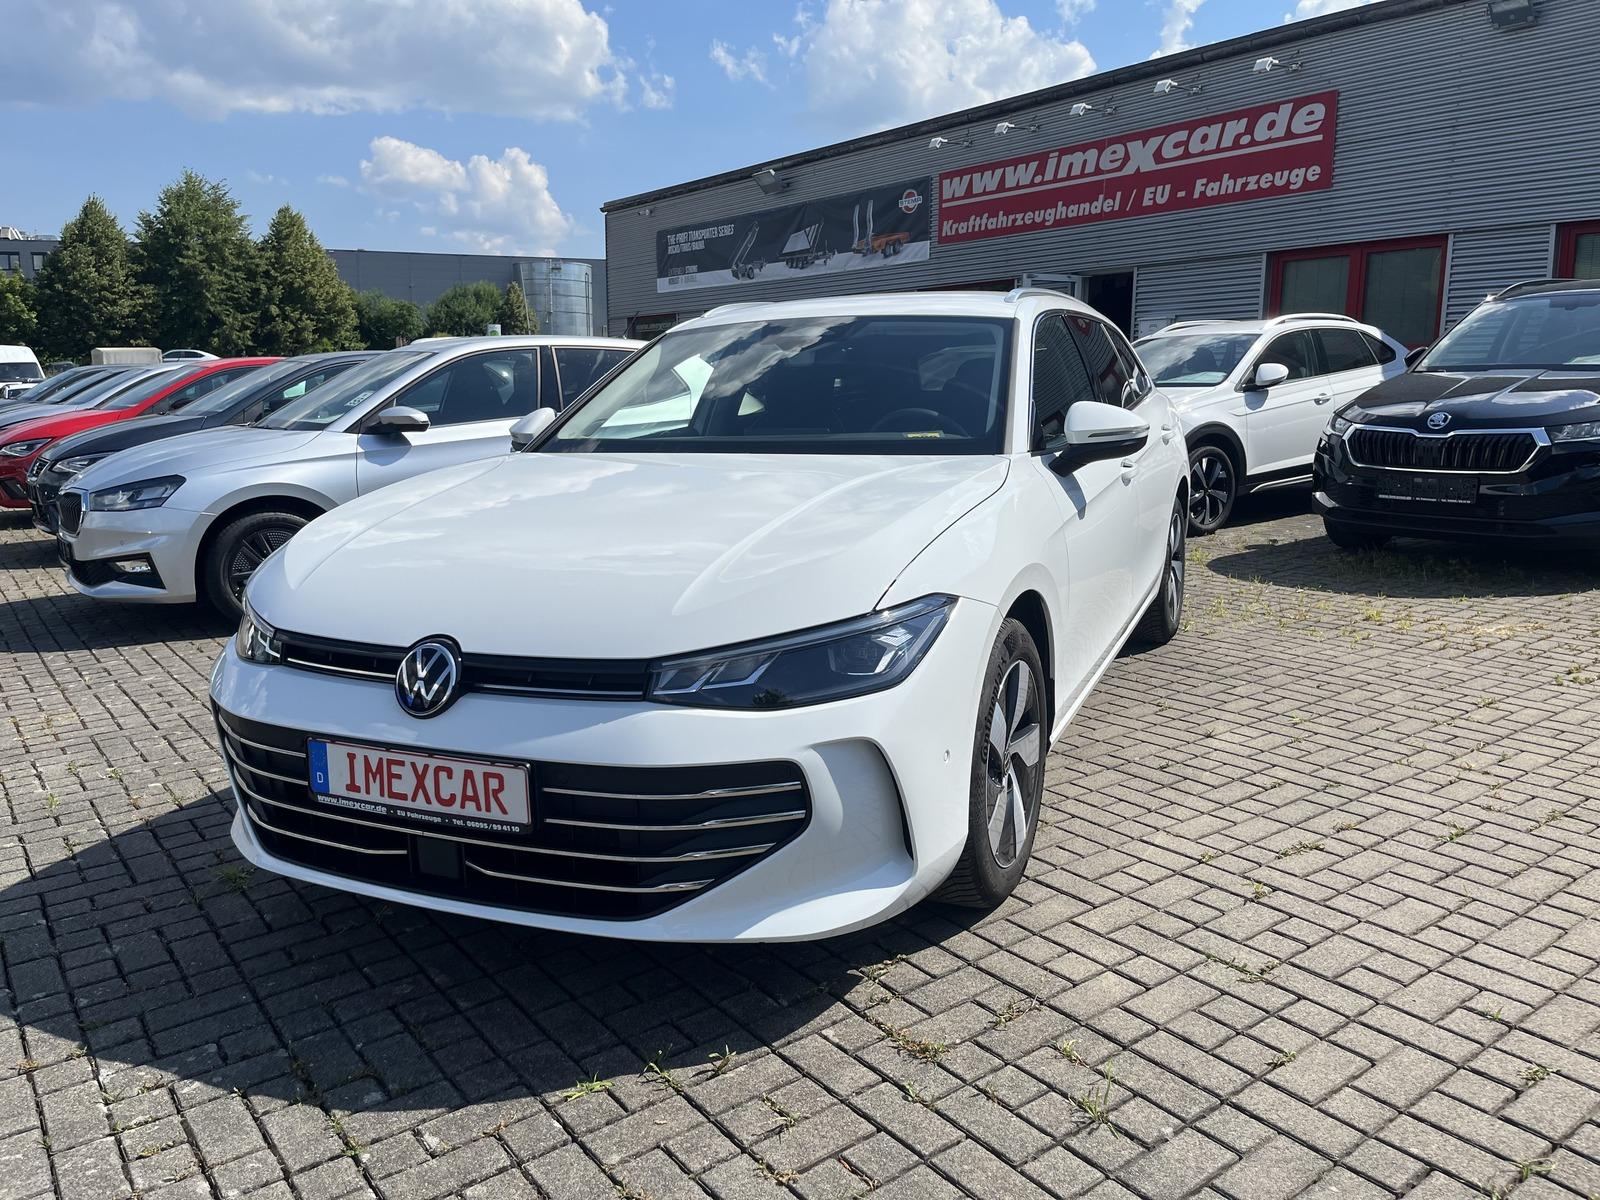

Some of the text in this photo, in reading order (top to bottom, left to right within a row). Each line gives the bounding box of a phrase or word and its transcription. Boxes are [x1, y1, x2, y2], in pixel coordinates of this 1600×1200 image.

[942, 102, 1326, 200] www.imexcar.de
[942, 191, 1122, 237] Kraftfahrzeughandel
[1142, 184, 1172, 207] EU
[1193, 165, 1322, 200] Fahrzeuge
[316, 771, 324, 784] D
[345, 752, 509, 816] IMEXCAR
[317, 794, 388, 814] www.imexcar.de
[406, 811, 442, 823] Fahrzeuge
[452, 818, 466, 826] Tel.
